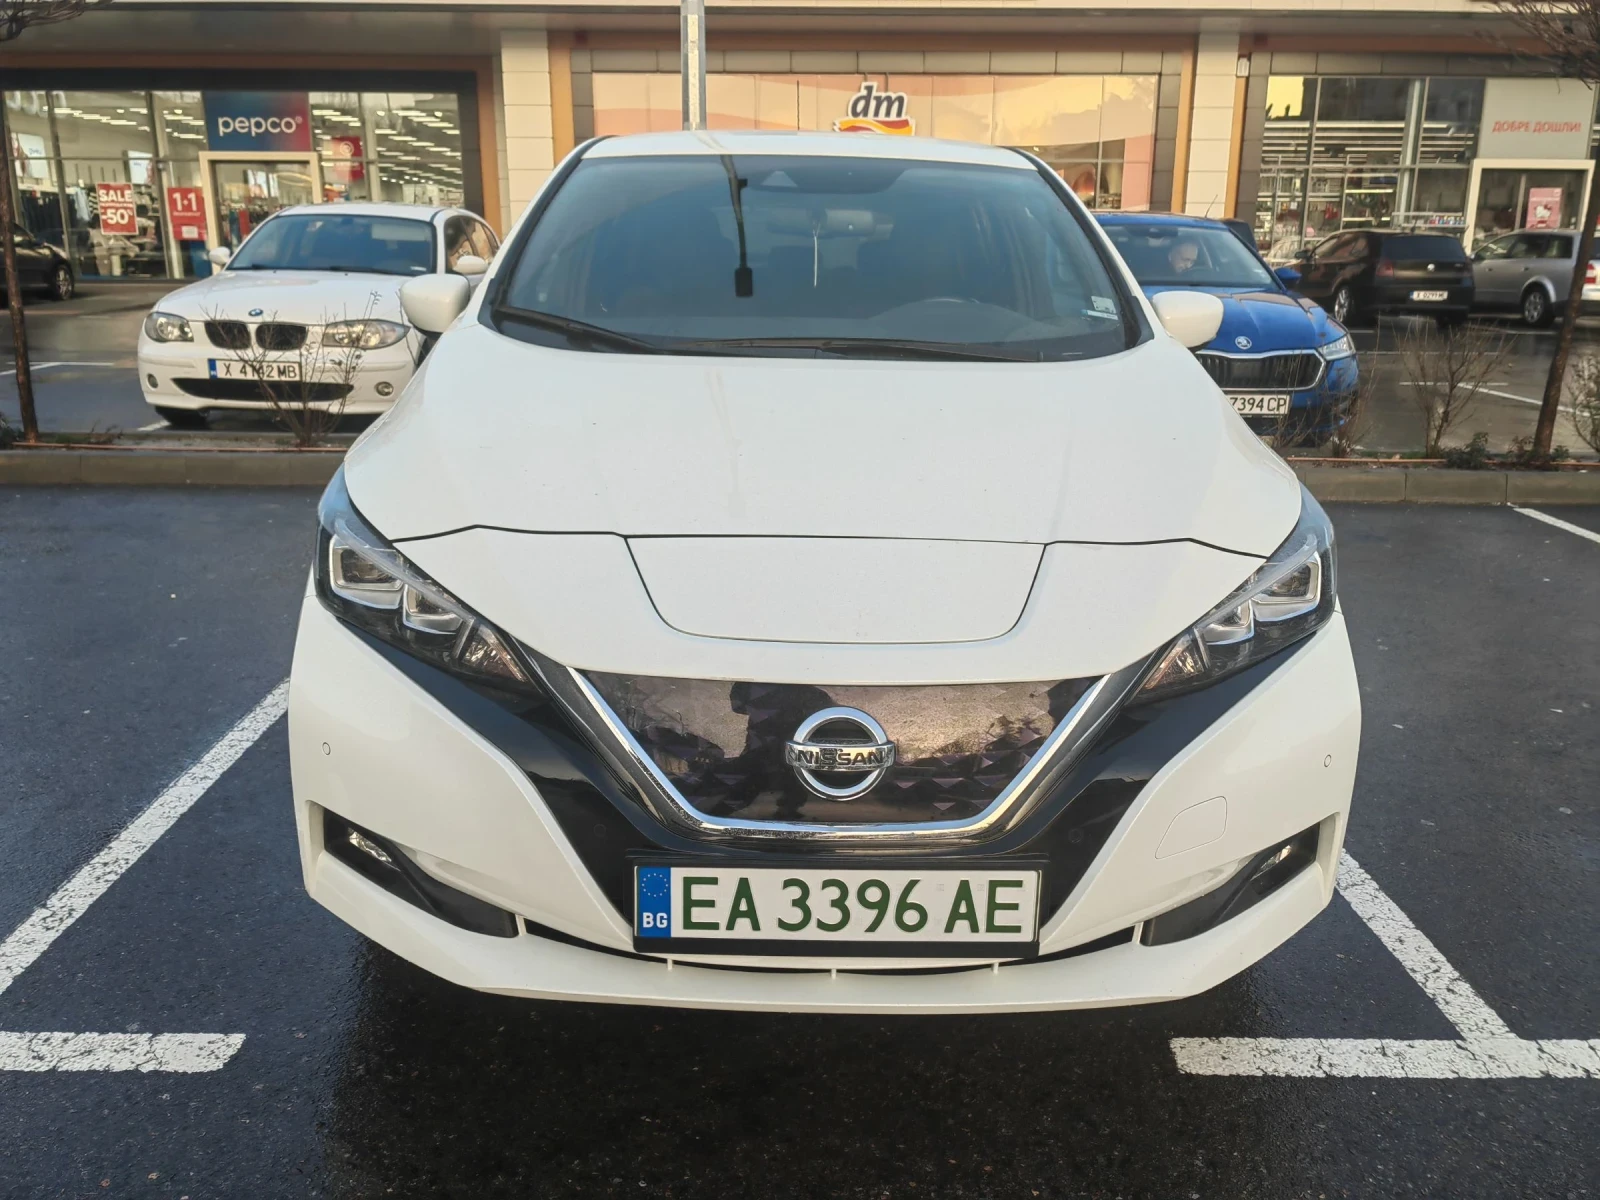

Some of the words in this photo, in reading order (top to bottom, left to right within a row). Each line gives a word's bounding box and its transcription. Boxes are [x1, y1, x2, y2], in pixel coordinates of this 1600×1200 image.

[851, 84, 905, 118] dm
[1492, 121, 1530, 133] ДОБРЕ
[1533, 121, 1582, 133] ДОШЛИ!
[98, 189, 133, 203] SALE
[797, 748, 884, 766] NISSAN
[642, 911, 668, 929] BG
[682, 876, 761, 932] EA
[777, 877, 929, 933] 3396
[943, 879, 1024, 934] AE
